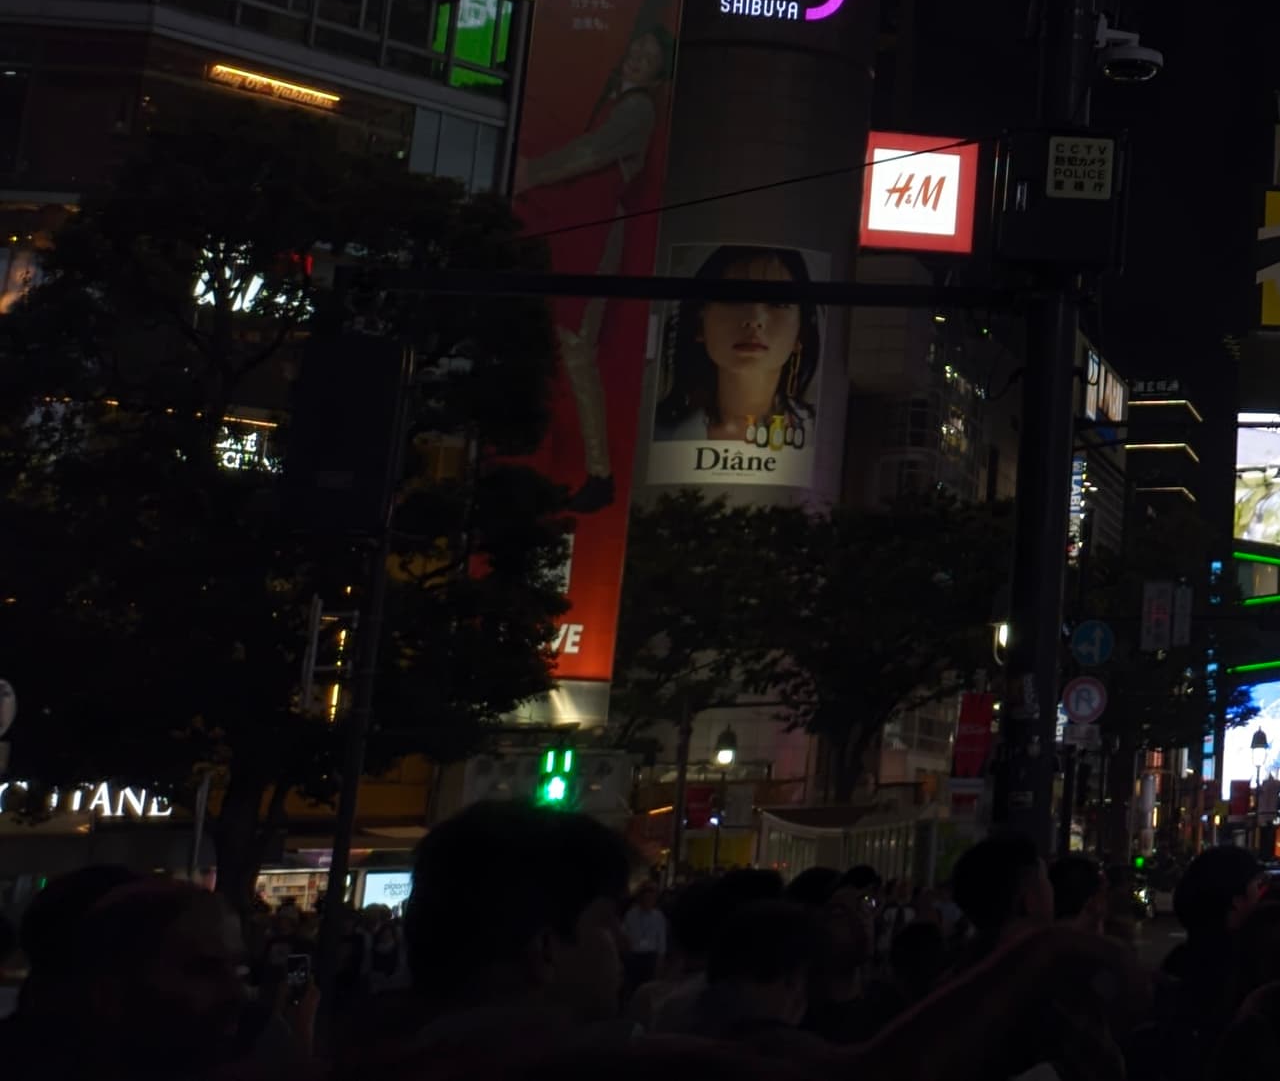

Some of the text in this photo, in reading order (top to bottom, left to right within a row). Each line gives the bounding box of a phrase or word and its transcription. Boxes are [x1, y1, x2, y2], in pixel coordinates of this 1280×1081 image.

[1055, 168, 1106, 181] POLICE
[884, 172, 947, 212] H&M
[694, 447, 777, 471] Diâne
